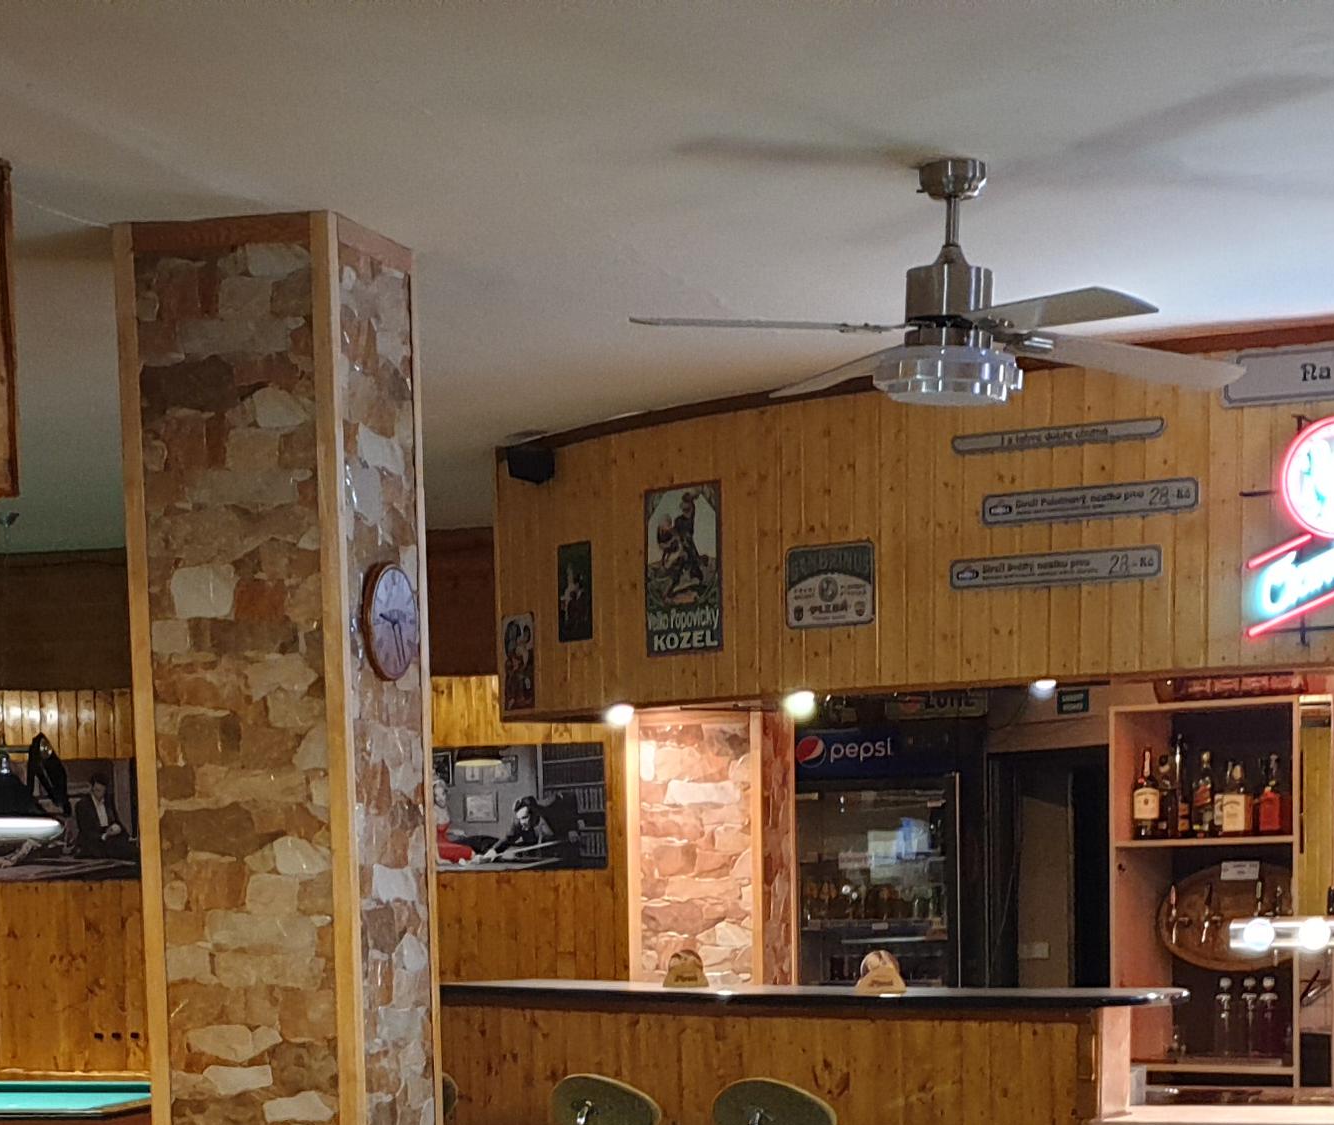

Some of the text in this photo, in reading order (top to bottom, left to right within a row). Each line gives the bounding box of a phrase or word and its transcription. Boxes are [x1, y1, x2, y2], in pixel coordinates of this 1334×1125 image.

[1300, 362, 1332, 382] Na
[653, 628, 719, 652] KOZEL
[830, 737, 892, 763] pepsi
